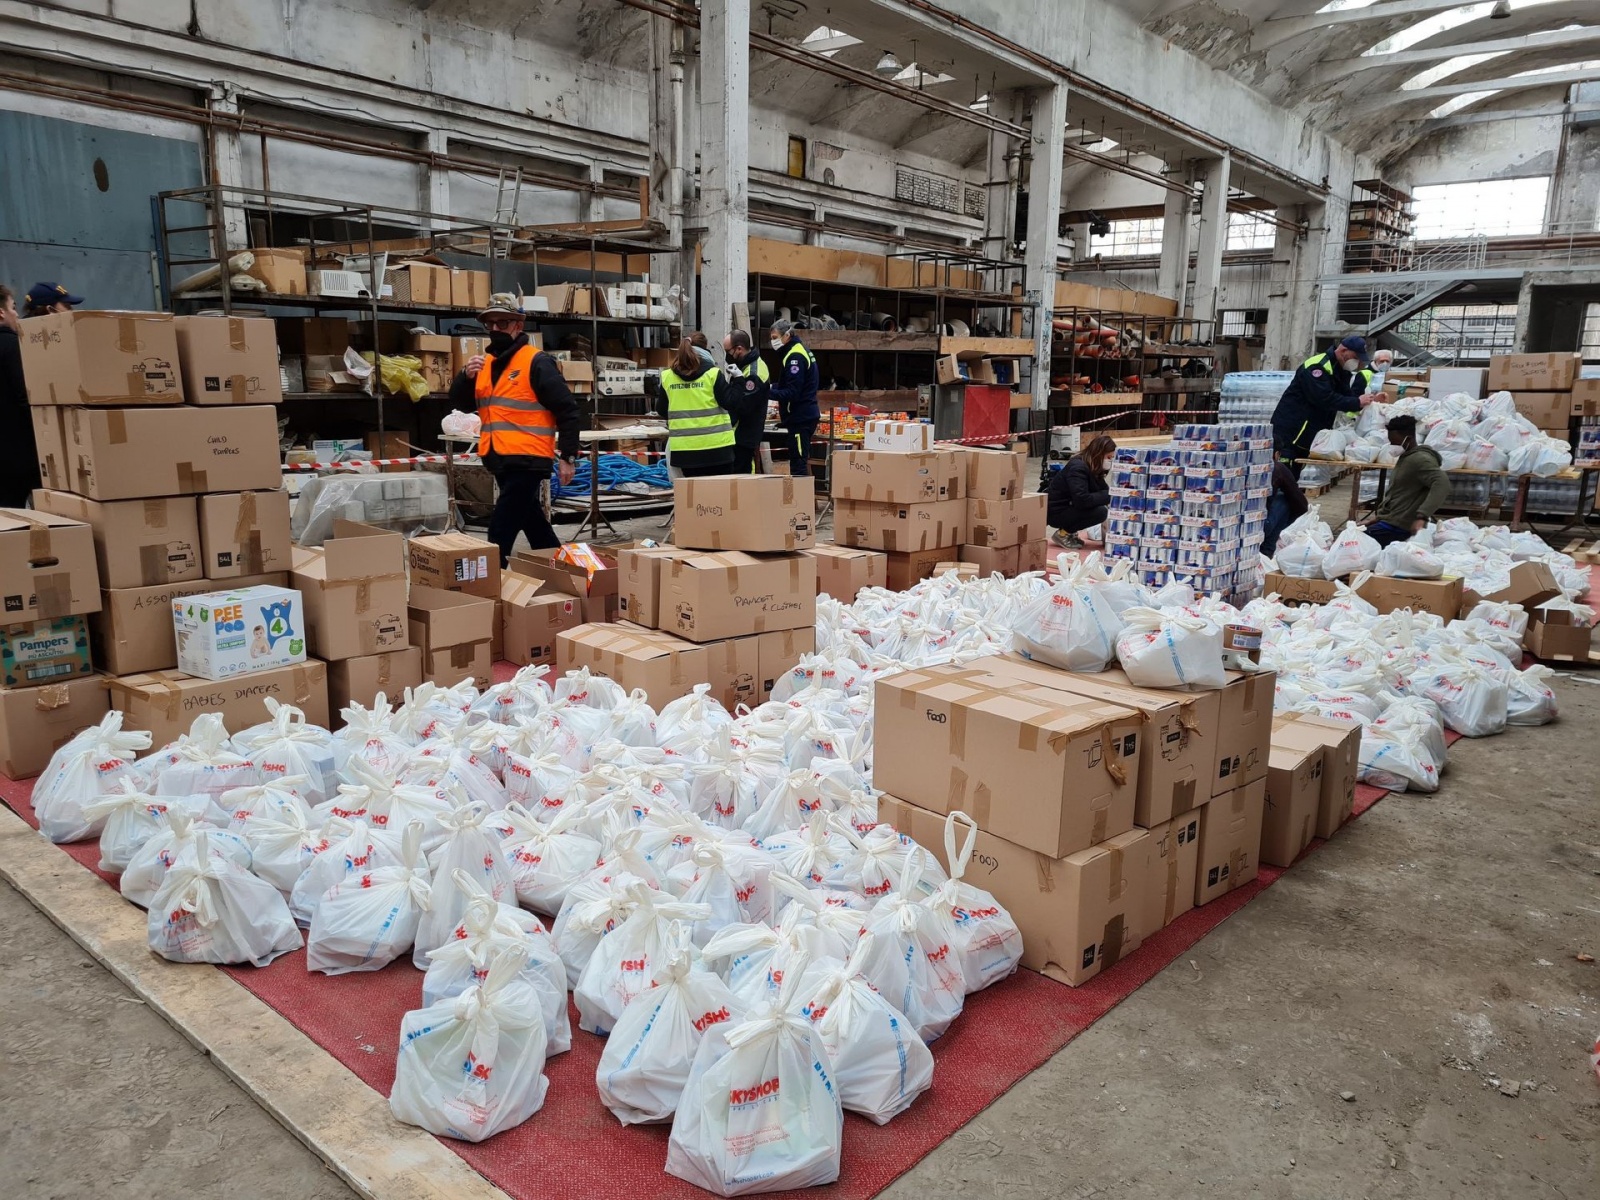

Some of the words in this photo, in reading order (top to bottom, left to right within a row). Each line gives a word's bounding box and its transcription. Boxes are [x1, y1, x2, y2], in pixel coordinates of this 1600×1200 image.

[213, 604, 243, 622] PEE
[215, 619, 245, 636] POO
[271, 618, 284, 634] 4
[20, 636, 69, 652] Pampers
[182, 692, 226, 712] BABIES
[234, 683, 281, 701] DIAPERS
[926, 708, 947, 725] FOOD
